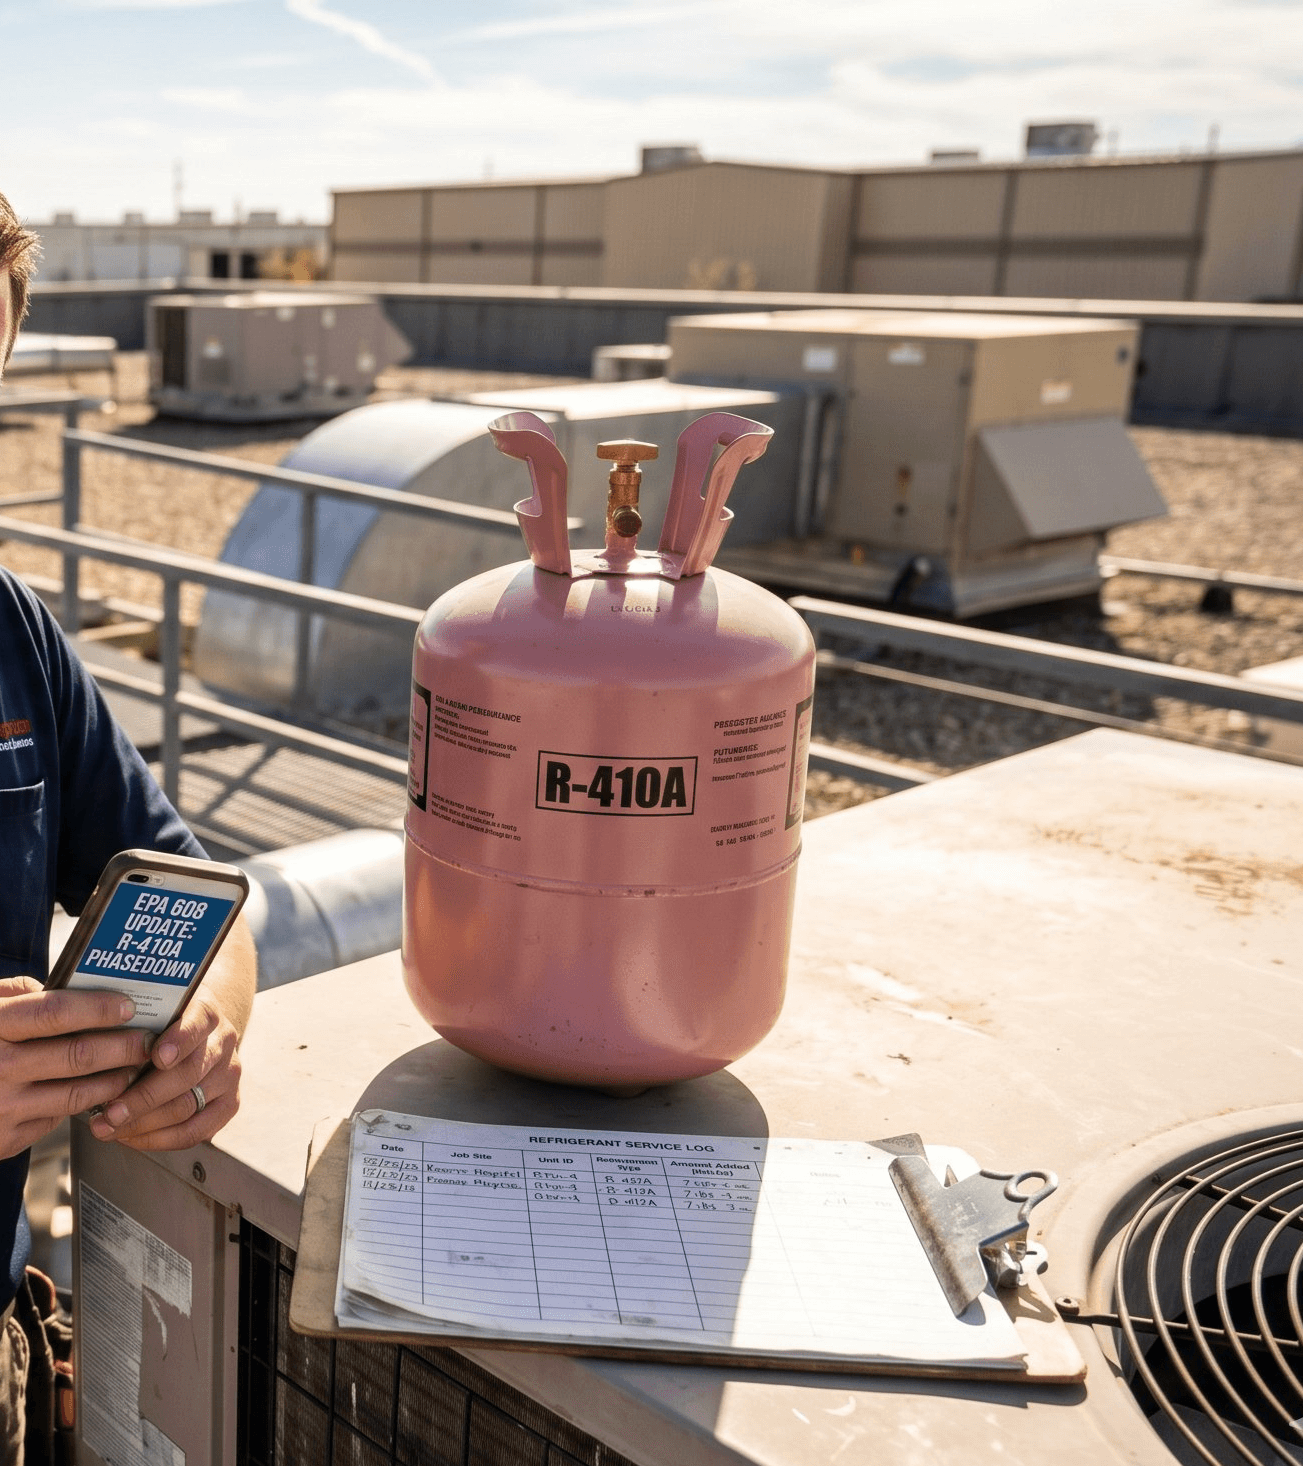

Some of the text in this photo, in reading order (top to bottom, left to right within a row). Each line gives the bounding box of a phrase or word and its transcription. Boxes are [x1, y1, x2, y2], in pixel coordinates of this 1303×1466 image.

[545, 760, 687, 809] R-410A
[133, 892, 208, 920] EPA 608
[124, 912, 197, 940] UPDATE:
[116, 932, 184, 958] R-410A
[85, 949, 195, 979] PHASEDOWN
[381, 1144, 404, 1153] Date
[529, 1136, 715, 1153] REFRIGERANT SERVICE LOG
